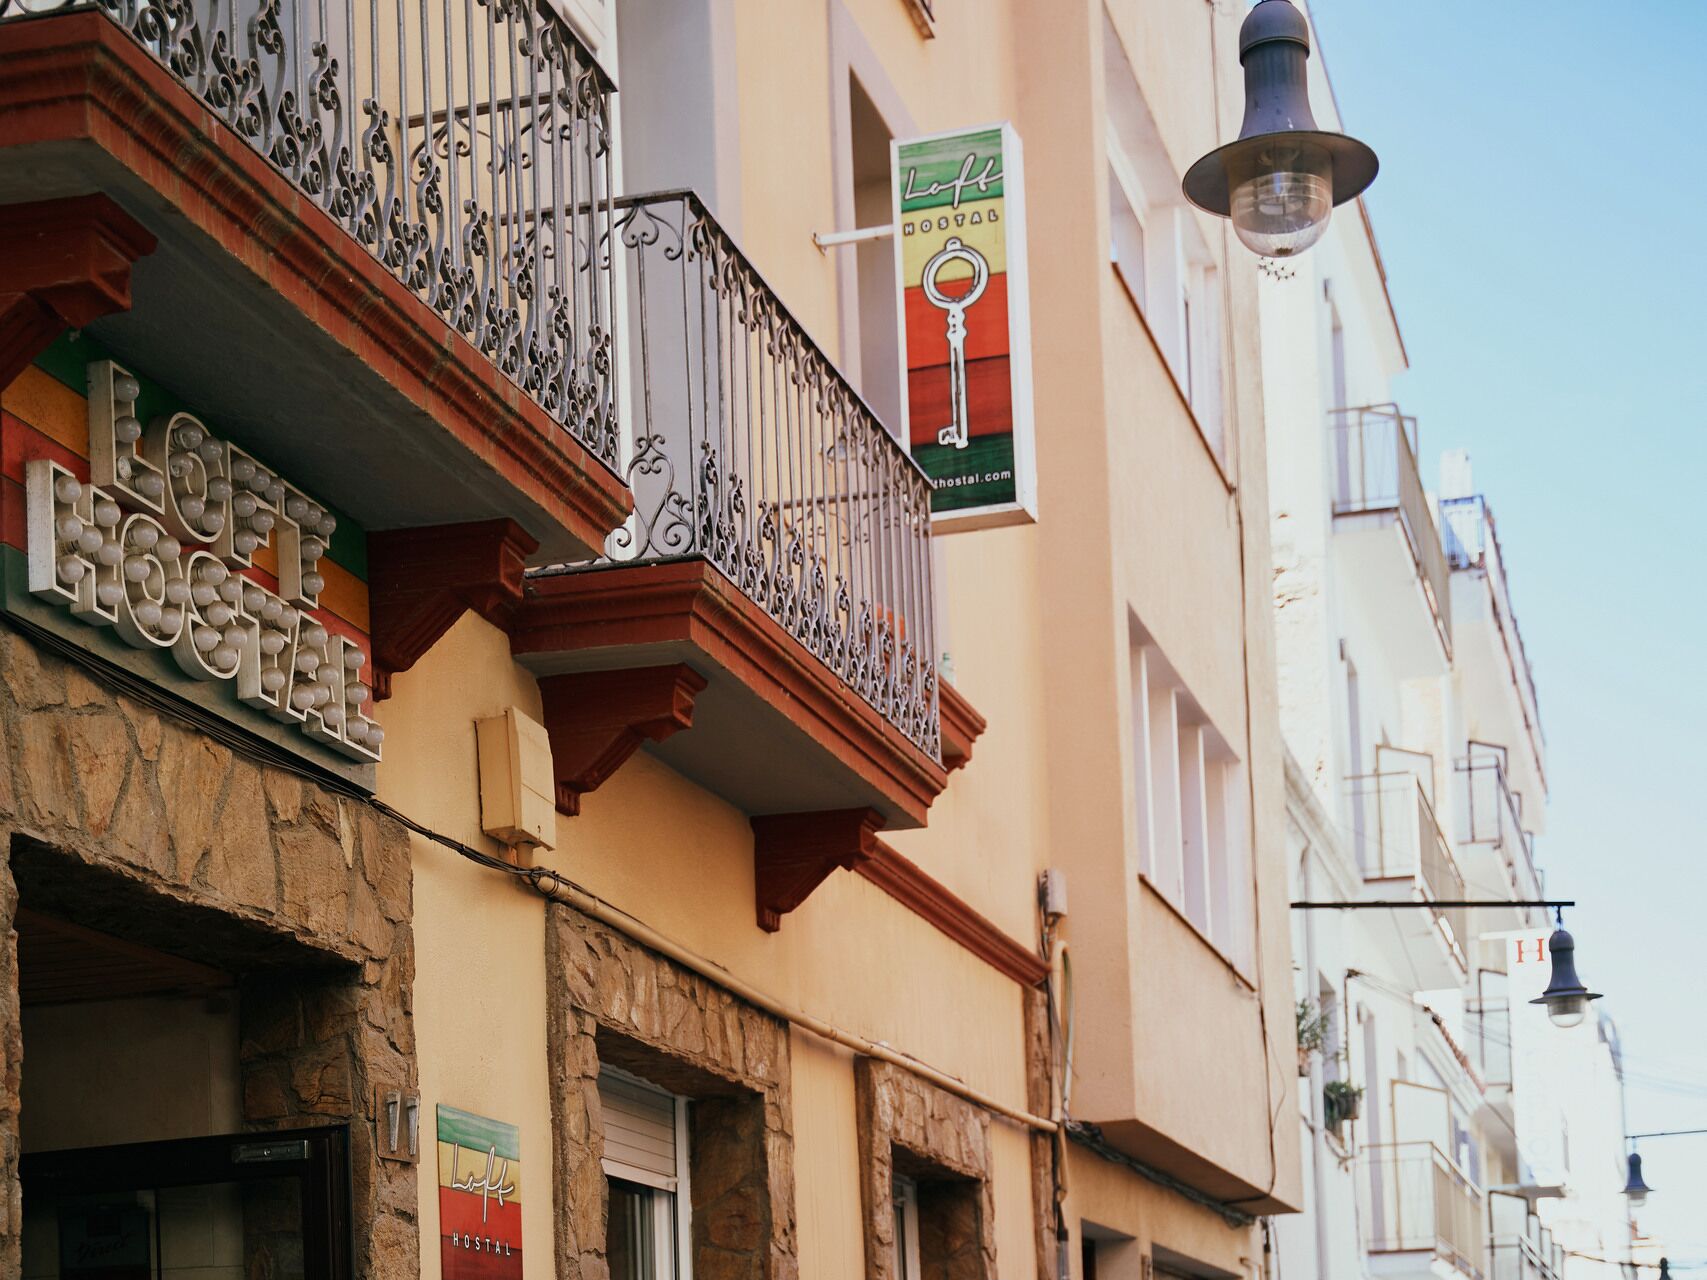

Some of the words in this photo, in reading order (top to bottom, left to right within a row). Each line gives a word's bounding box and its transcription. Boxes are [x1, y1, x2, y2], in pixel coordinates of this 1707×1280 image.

[903, 209, 999, 236] HOSTAL
[88, 360, 335, 610] LOFT
[932, 470, 1011, 489] thostal.com
[27, 459, 382, 763] HOSTAL
[452, 1143, 515, 1224] Loft
[453, 1232, 511, 1256] HOSTAL
